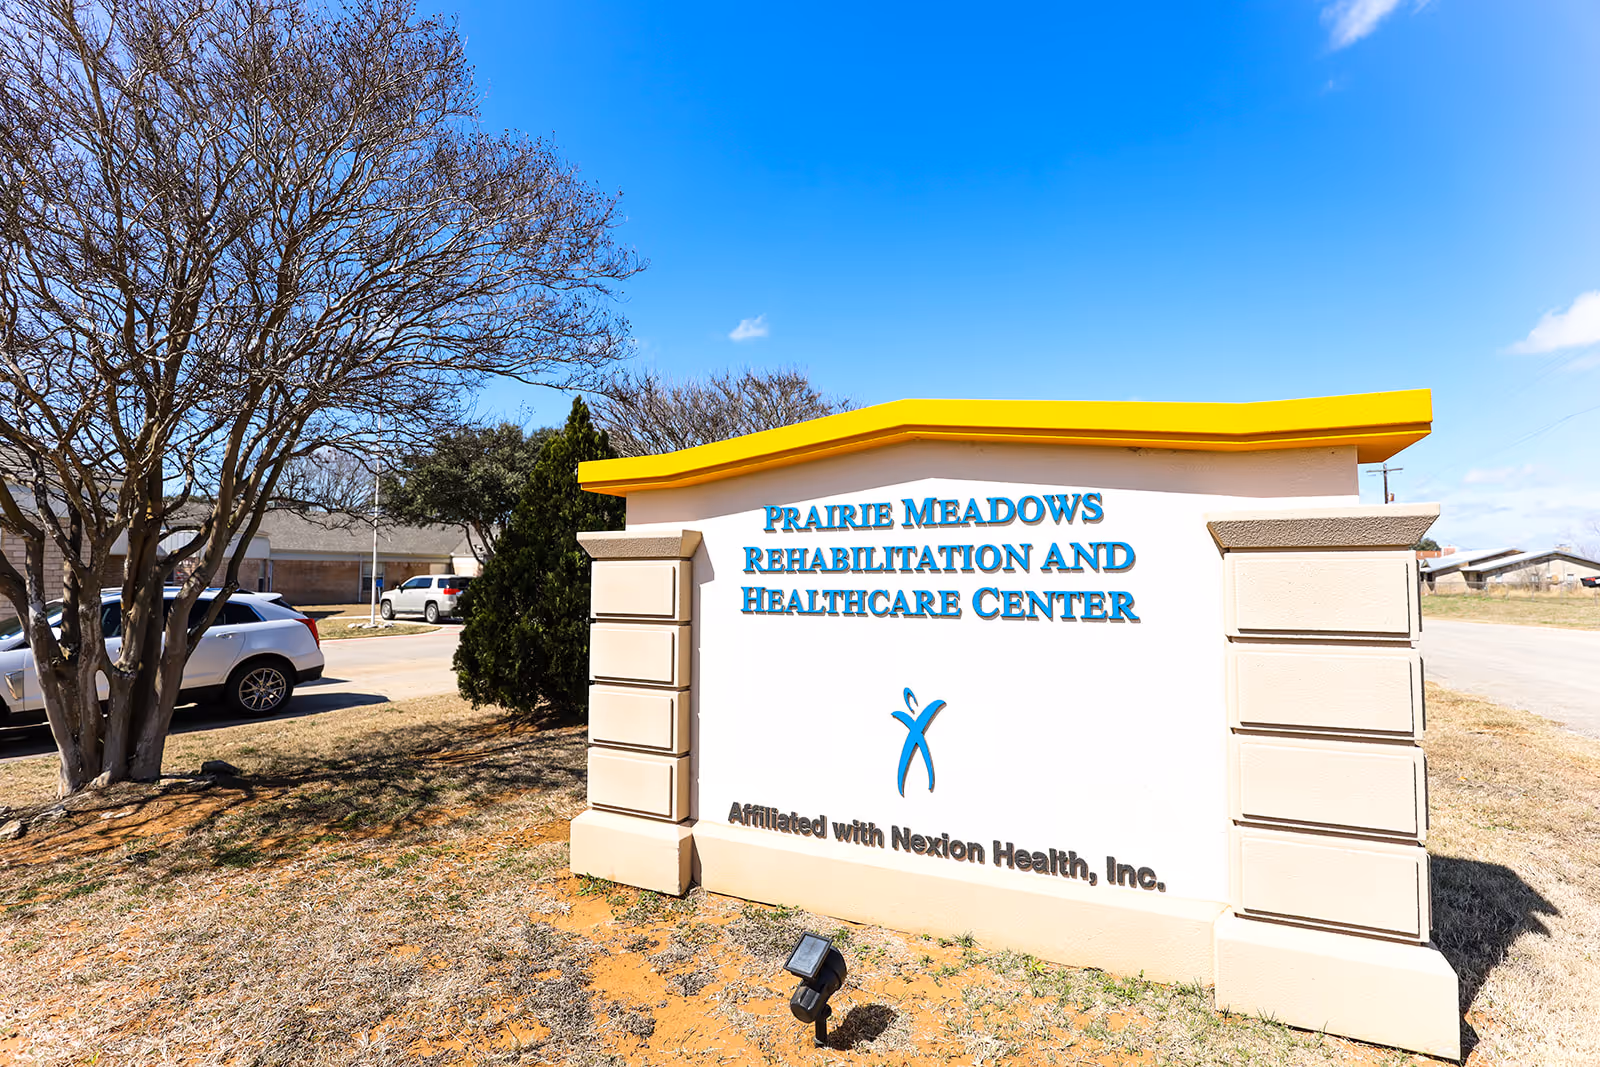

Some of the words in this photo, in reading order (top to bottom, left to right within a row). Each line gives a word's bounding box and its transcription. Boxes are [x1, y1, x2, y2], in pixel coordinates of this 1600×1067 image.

[764, 503, 893, 532] PRAIRIE
[901, 493, 1104, 528] MEADOWS
[743, 544, 1033, 573] REHABILITATION
[1040, 542, 1136, 572] AND
[740, 587, 961, 617] HEALTHCARE
[972, 587, 1140, 622] CENTER
[728, 801, 827, 839] Affiliated
[833, 819, 884, 848] with
[891, 825, 984, 863] Nexion
[993, 840, 1098, 886] Health,
[1106, 856, 1166, 892] Inc.
